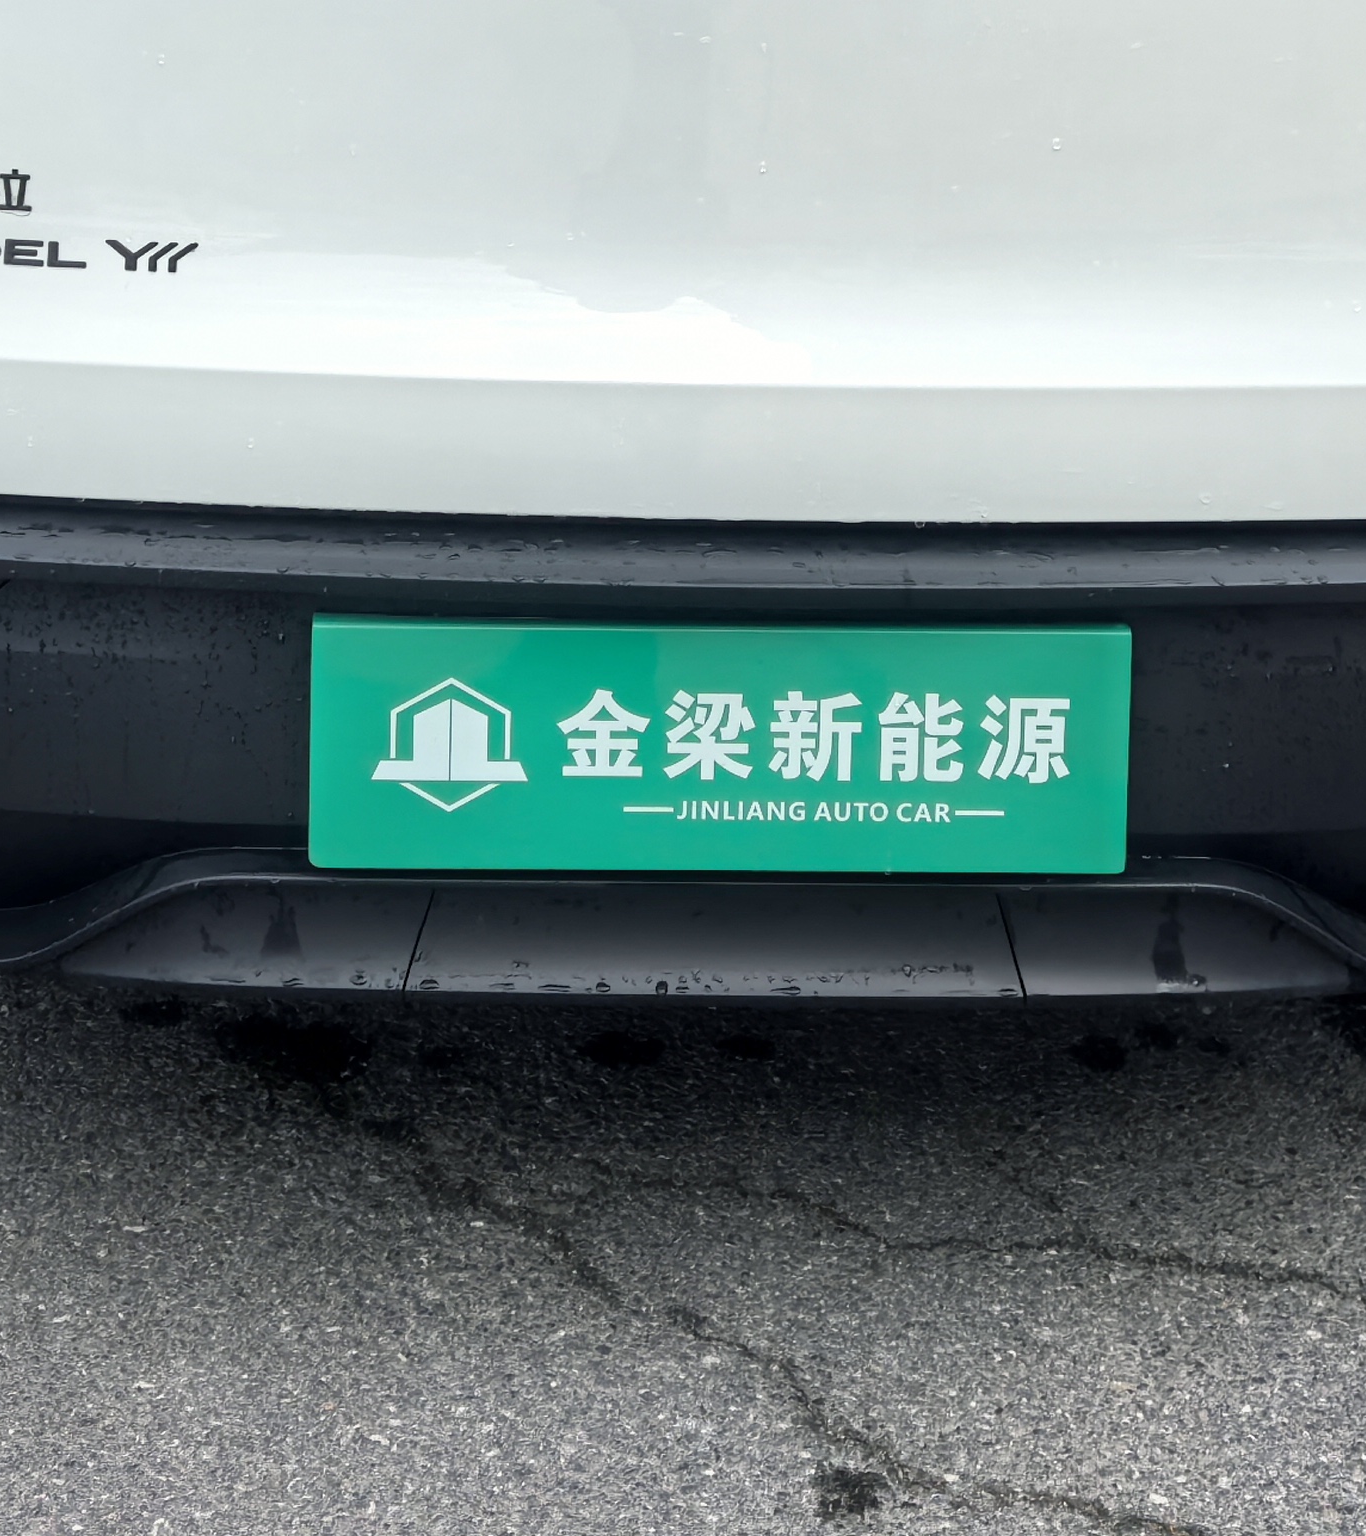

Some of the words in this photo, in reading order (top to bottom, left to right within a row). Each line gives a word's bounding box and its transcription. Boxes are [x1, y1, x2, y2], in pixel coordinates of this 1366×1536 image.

[556, 688, 1072, 785] 金梁新能源
[676, 798, 807, 823] JINLIANG
[813, 801, 890, 824] AUTO
[895, 802, 952, 825] CAR
